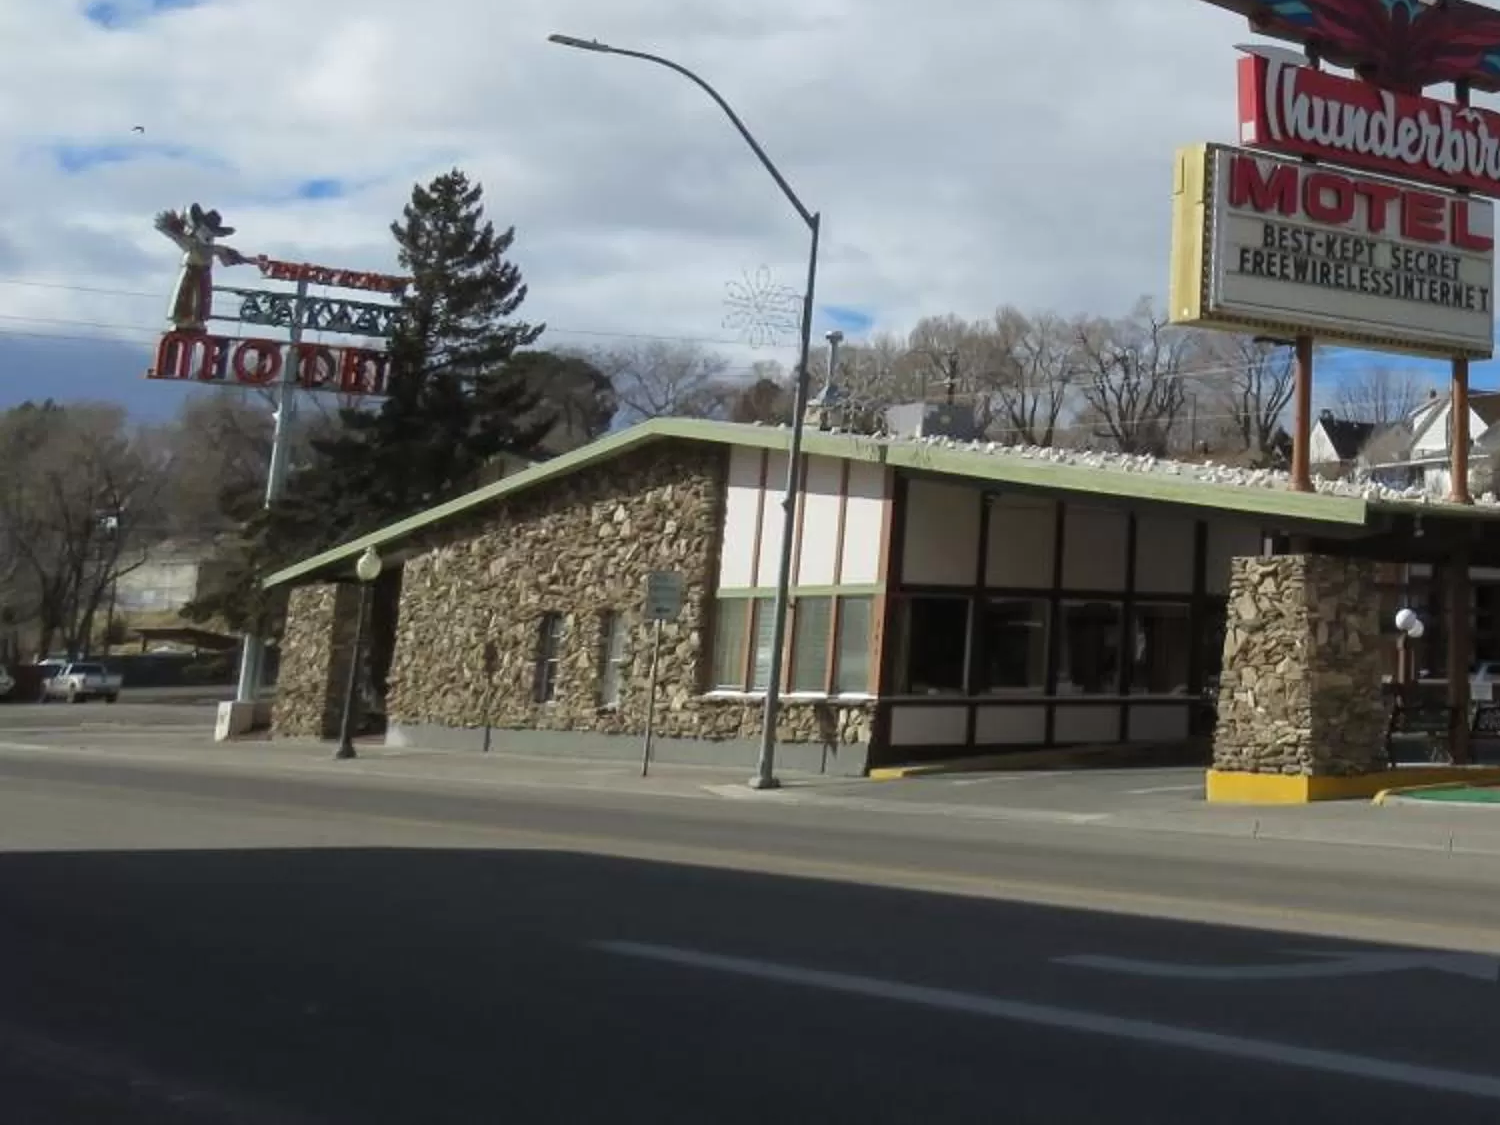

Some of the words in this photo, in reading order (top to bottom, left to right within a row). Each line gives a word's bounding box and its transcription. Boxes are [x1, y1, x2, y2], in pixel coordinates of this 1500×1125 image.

[1229, 156, 1494, 251] MOTEL
[1263, 225, 1377, 269] BEST-KEPT
[1391, 245, 1461, 280] SECRET
